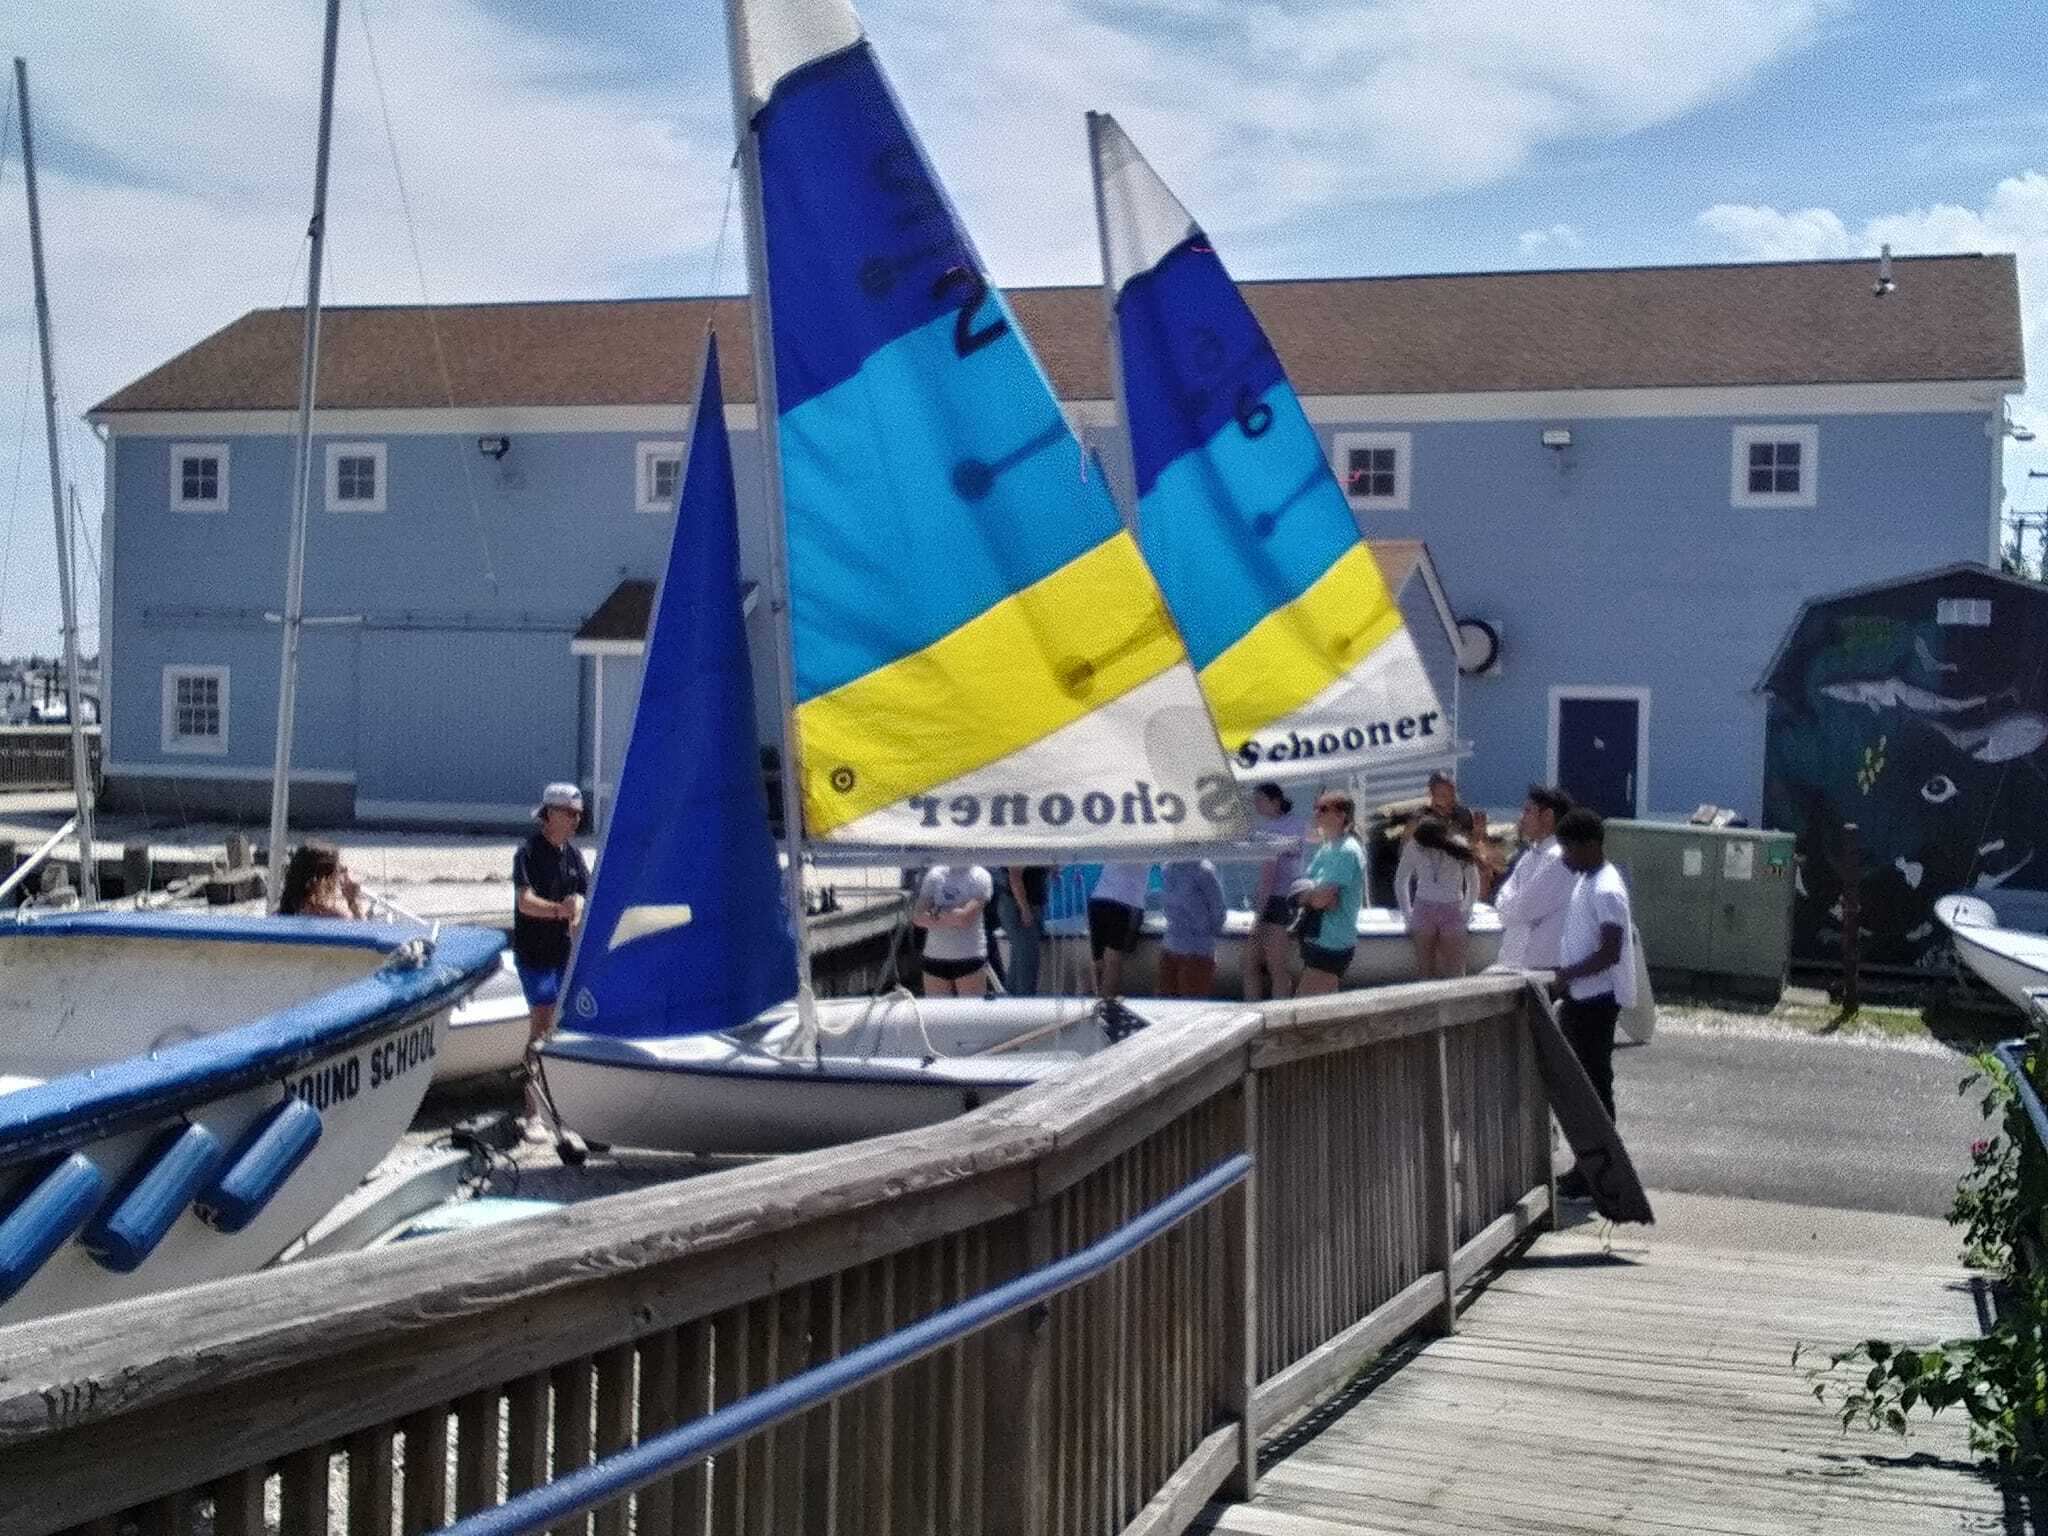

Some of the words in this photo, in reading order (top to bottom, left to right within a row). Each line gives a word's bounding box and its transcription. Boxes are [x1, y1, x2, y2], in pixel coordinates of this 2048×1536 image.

[930, 266, 1010, 360] 2
[1237, 384, 1273, 439] 6
[1235, 710, 1439, 769] Schooner
[371, 1022, 436, 1089] SCHOOL
